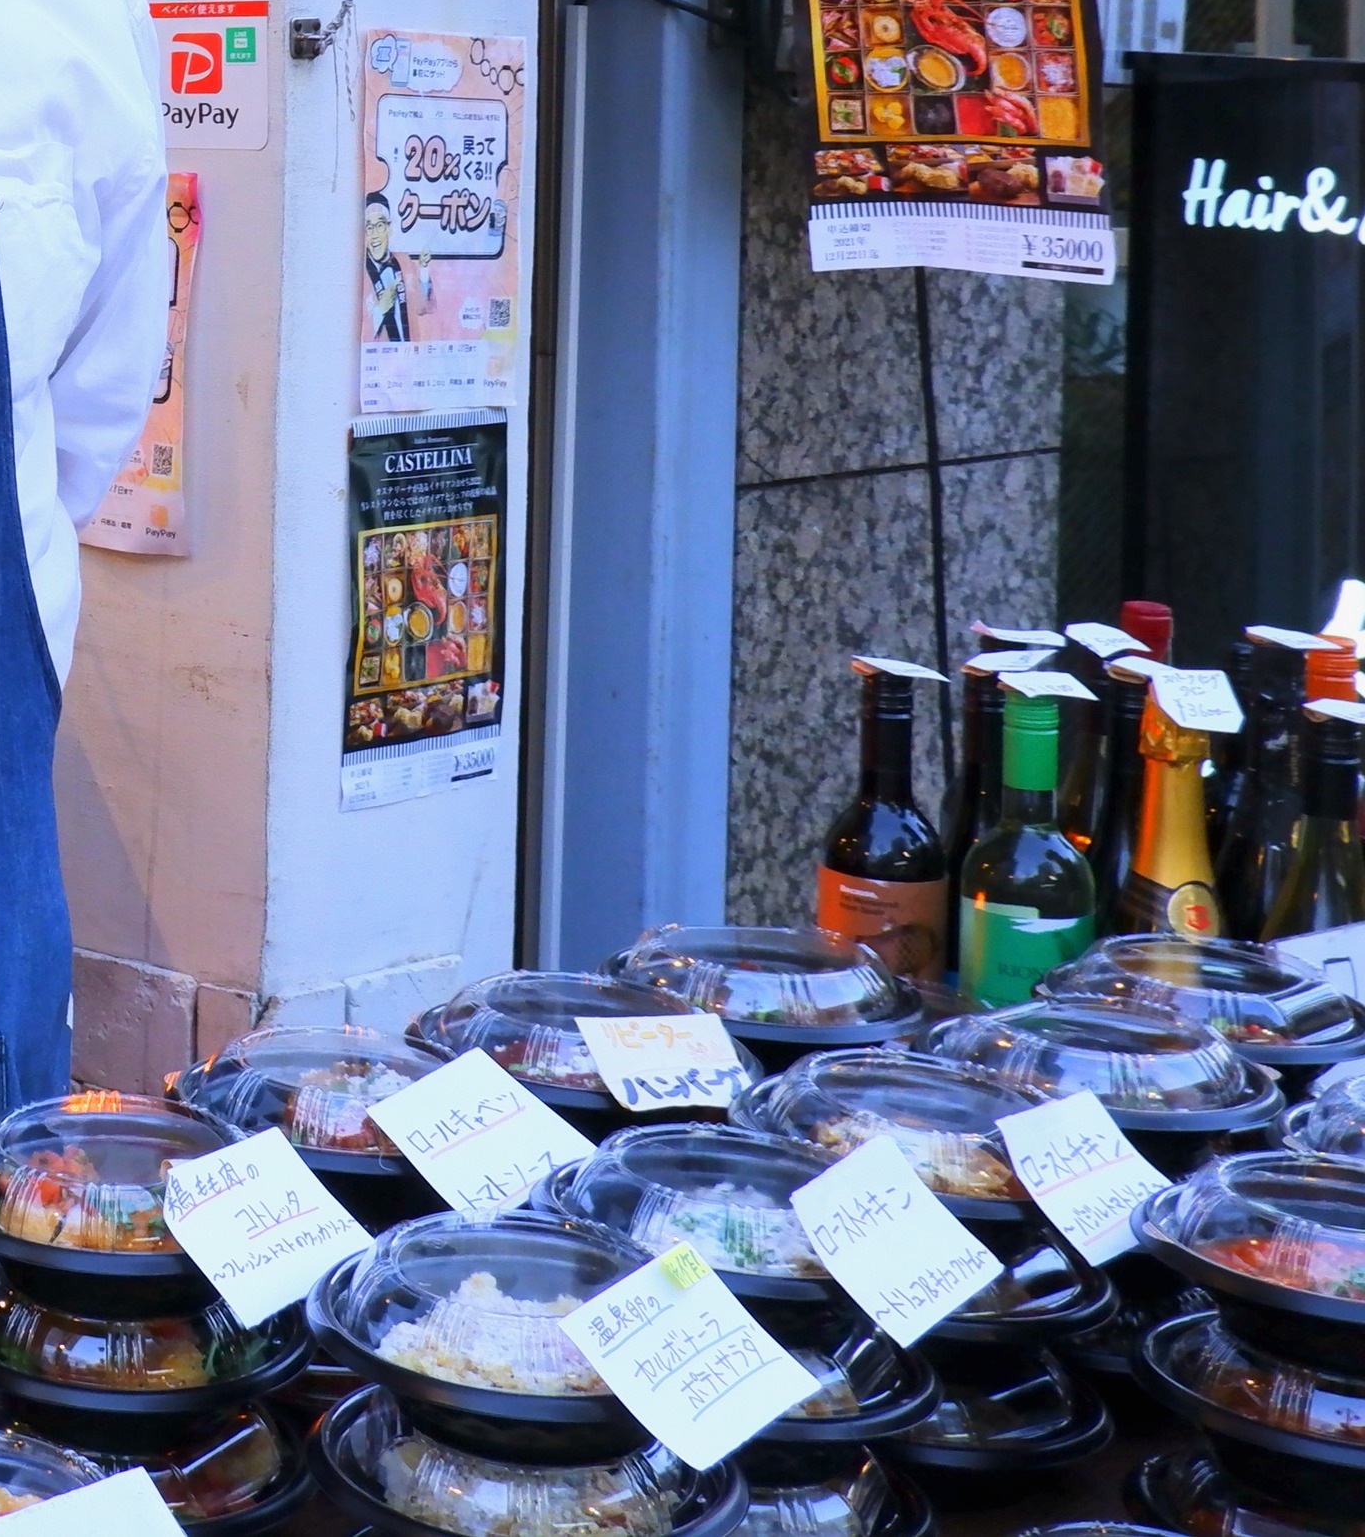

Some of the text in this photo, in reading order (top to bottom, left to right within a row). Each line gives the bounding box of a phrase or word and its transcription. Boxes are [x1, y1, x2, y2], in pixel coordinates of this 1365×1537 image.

[404, 134, 461, 183] 20%
[463, 135, 497, 156] 戻って
[398, 187, 492, 235] クーポン
[1182, 157, 1365, 245] Hair&
[384, 447, 474, 473] CASTELLINA
[145, 527, 176, 539] PayPay
[406, 1092, 521, 1154] ロールキャベツ
[457, 1150, 560, 1211] トマトソース
[1020, 1132, 1121, 1189] ローストチキン
[234, 1190, 301, 1233] コトレッタ
[812, 1186, 912, 1256] ローストチキン
[634, 1311, 724, 1384] カルボナーラ
[680, 1322, 765, 1409] ポテトサラダ
